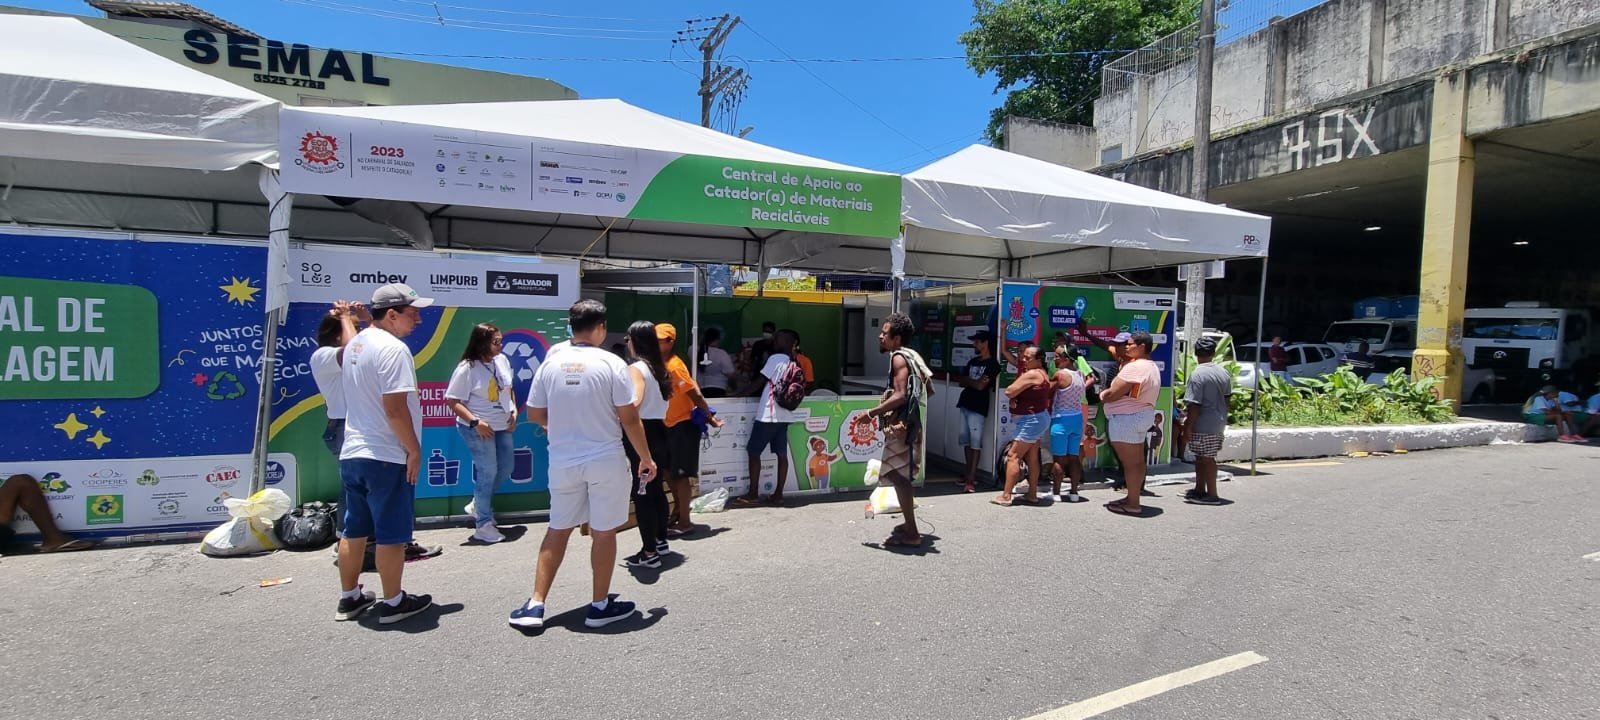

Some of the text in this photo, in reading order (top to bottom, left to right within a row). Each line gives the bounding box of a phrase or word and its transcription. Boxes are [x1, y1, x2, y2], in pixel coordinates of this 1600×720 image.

[183, 28, 390, 86] SEMAL
[370, 145, 404, 158] 2023
[722, 166, 862, 193] Central de Apoio ao
[704, 184, 873, 212] Catador(a) de Materiais
[751, 207, 829, 226] Recicláveis
[1244, 235, 1255, 244] RP
[430, 274, 478, 286] LIMPURB
[512, 278, 552, 287] SALVADOR
[58, 297, 105, 333] DE
[200, 325, 263, 343] JUNTOS
[215, 344, 246, 353] PELO
[0, 346, 114, 381] AGEM
[201, 357, 229, 367] QUE
[206, 469, 241, 483] CAEC
